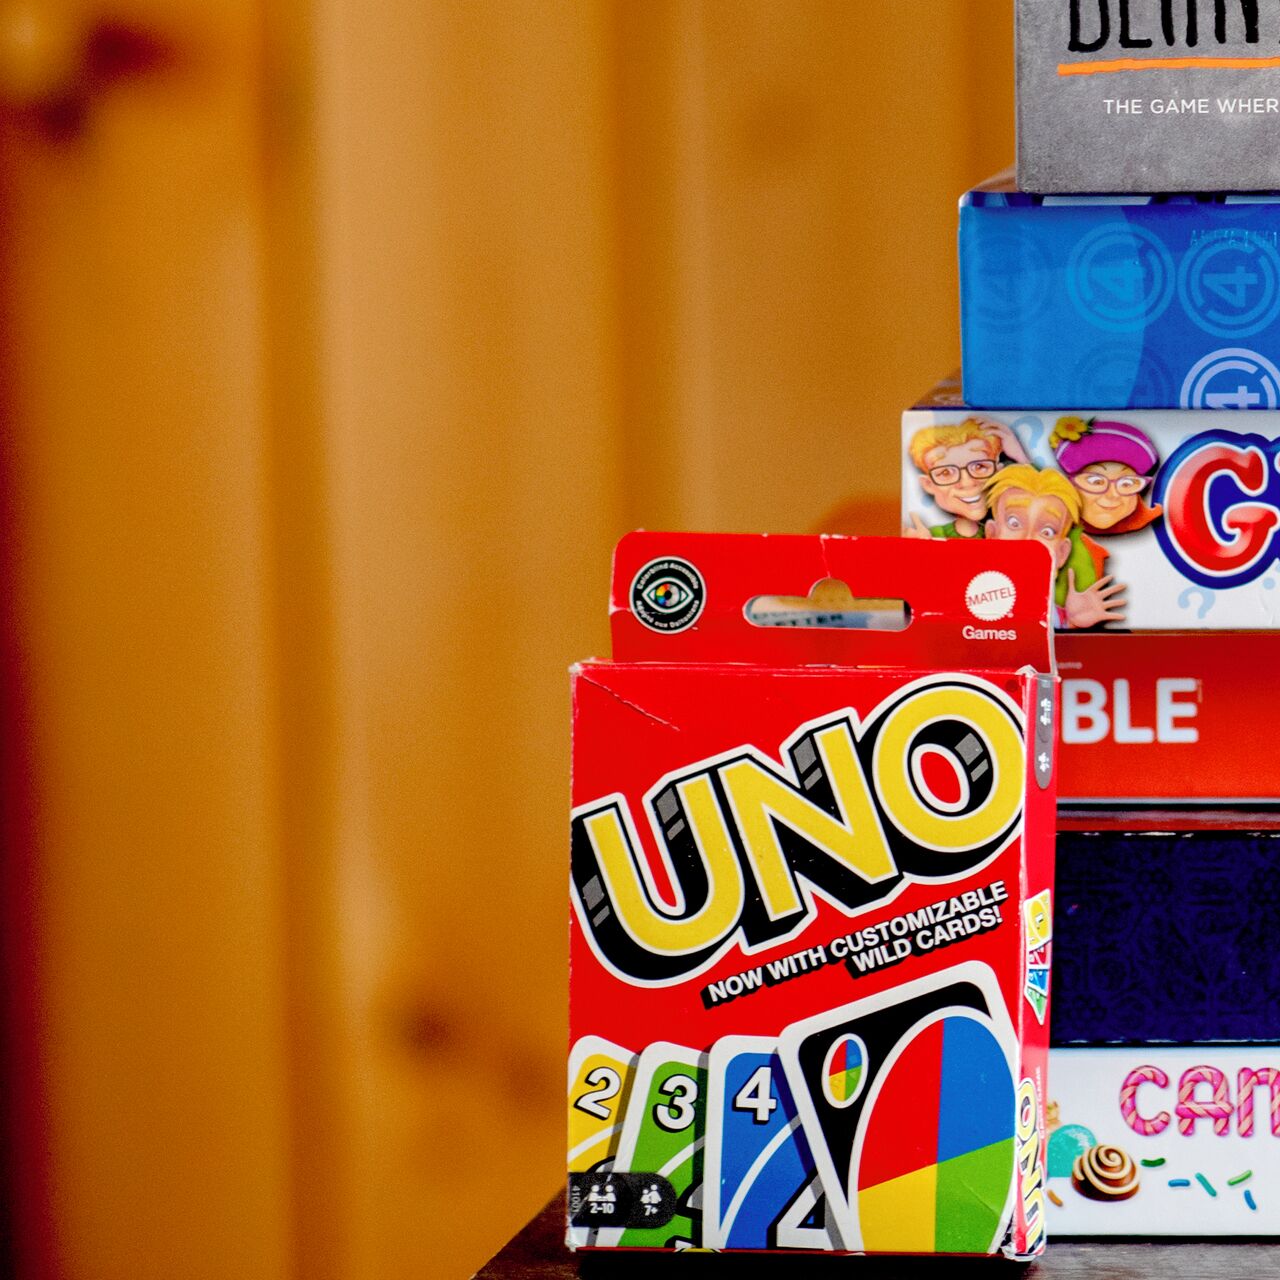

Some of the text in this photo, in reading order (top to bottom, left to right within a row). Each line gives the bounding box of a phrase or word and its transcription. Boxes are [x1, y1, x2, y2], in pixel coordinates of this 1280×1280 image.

[1103, 99, 1144, 114] THE
[1150, 98, 1209, 114] GAME
[969, 587, 1015, 606] MATTEL
[962, 625, 1017, 640] Games
[1062, 677, 1198, 744] BLE
[573, 678, 1026, 978] UNO
[706, 881, 1009, 1005] NOW WITH CUSTOMIZABLE
[851, 906, 1004, 976] WILD CARDS!
[576, 1066, 621, 1120] 2
[655, 1074, 699, 1131] 3
[736, 1066, 777, 1124] 4
[1018, 1078, 1046, 1255] UNO
[590, 1203, 615, 1214] 2-10
[644, 1205, 659, 1216] 7+
